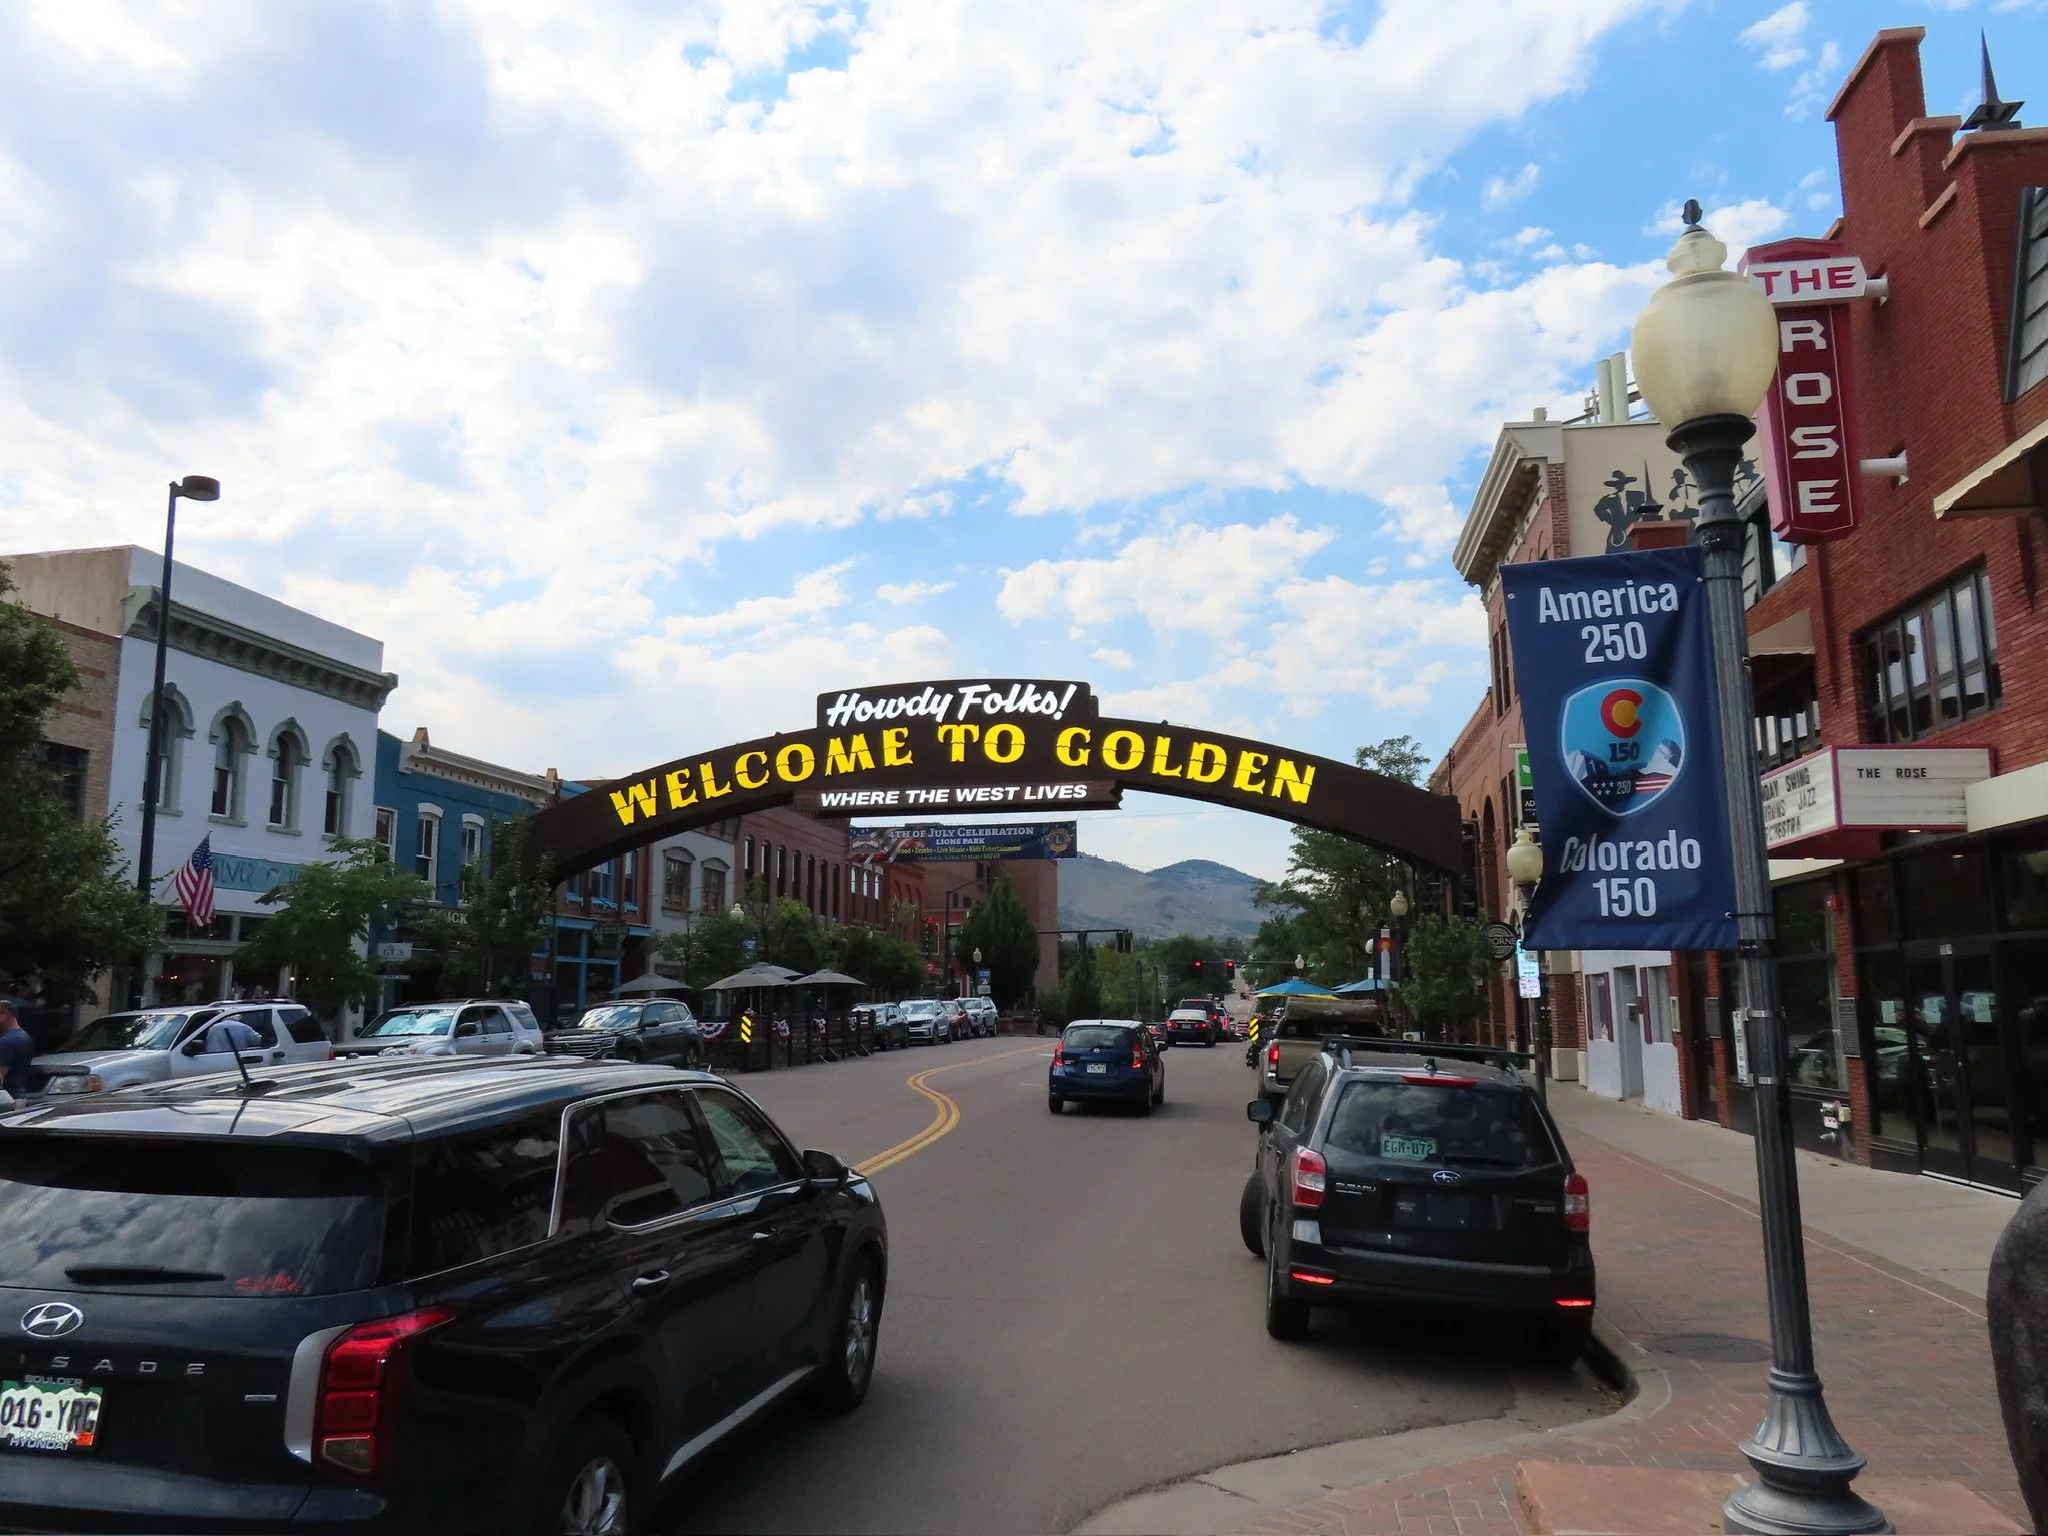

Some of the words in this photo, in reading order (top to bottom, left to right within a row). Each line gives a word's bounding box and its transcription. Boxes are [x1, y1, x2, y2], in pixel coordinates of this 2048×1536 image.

[1752, 265, 1857, 297] THE
[1779, 319, 1841, 515] ROSE
[1539, 579, 1679, 624] America
[1581, 621, 1648, 664] 250
[826, 685, 954, 727] Howdy
[957, 682, 1078, 722] Folks!
[1608, 741, 1640, 763] 150
[608, 726, 915, 827] WELCOME
[937, 722, 1026, 764] TO
[1054, 726, 1317, 805] GOLDEN
[1762, 780, 1779, 801] DAY
[1785, 767, 1811, 793] SWING
[1856, 767, 1881, 779] THE
[1895, 766, 1928, 779] ROSE
[820, 789, 900, 808] WHERE
[906, 788, 950, 805] THE
[955, 786, 1021, 803] WEST
[1024, 784, 1088, 801] LIVES
[1616, 780, 1632, 795] 250
[1798, 787, 1817, 811] JAZZ
[888, 830, 911, 839] 4TH
[912, 830, 927, 838] OF
[957, 826, 1035, 837] CELEBRATION
[936, 838, 962, 846] LIONS
[962, 837, 986, 845] PARK
[1560, 829, 1702, 875] Colorado
[1592, 877, 1658, 918] 150
[24, 1374, 84, 1387] BOULDER
[9, 1437, 70, 1451] HYUNDAI
[18, 1430, 72, 1443] COLORADO
